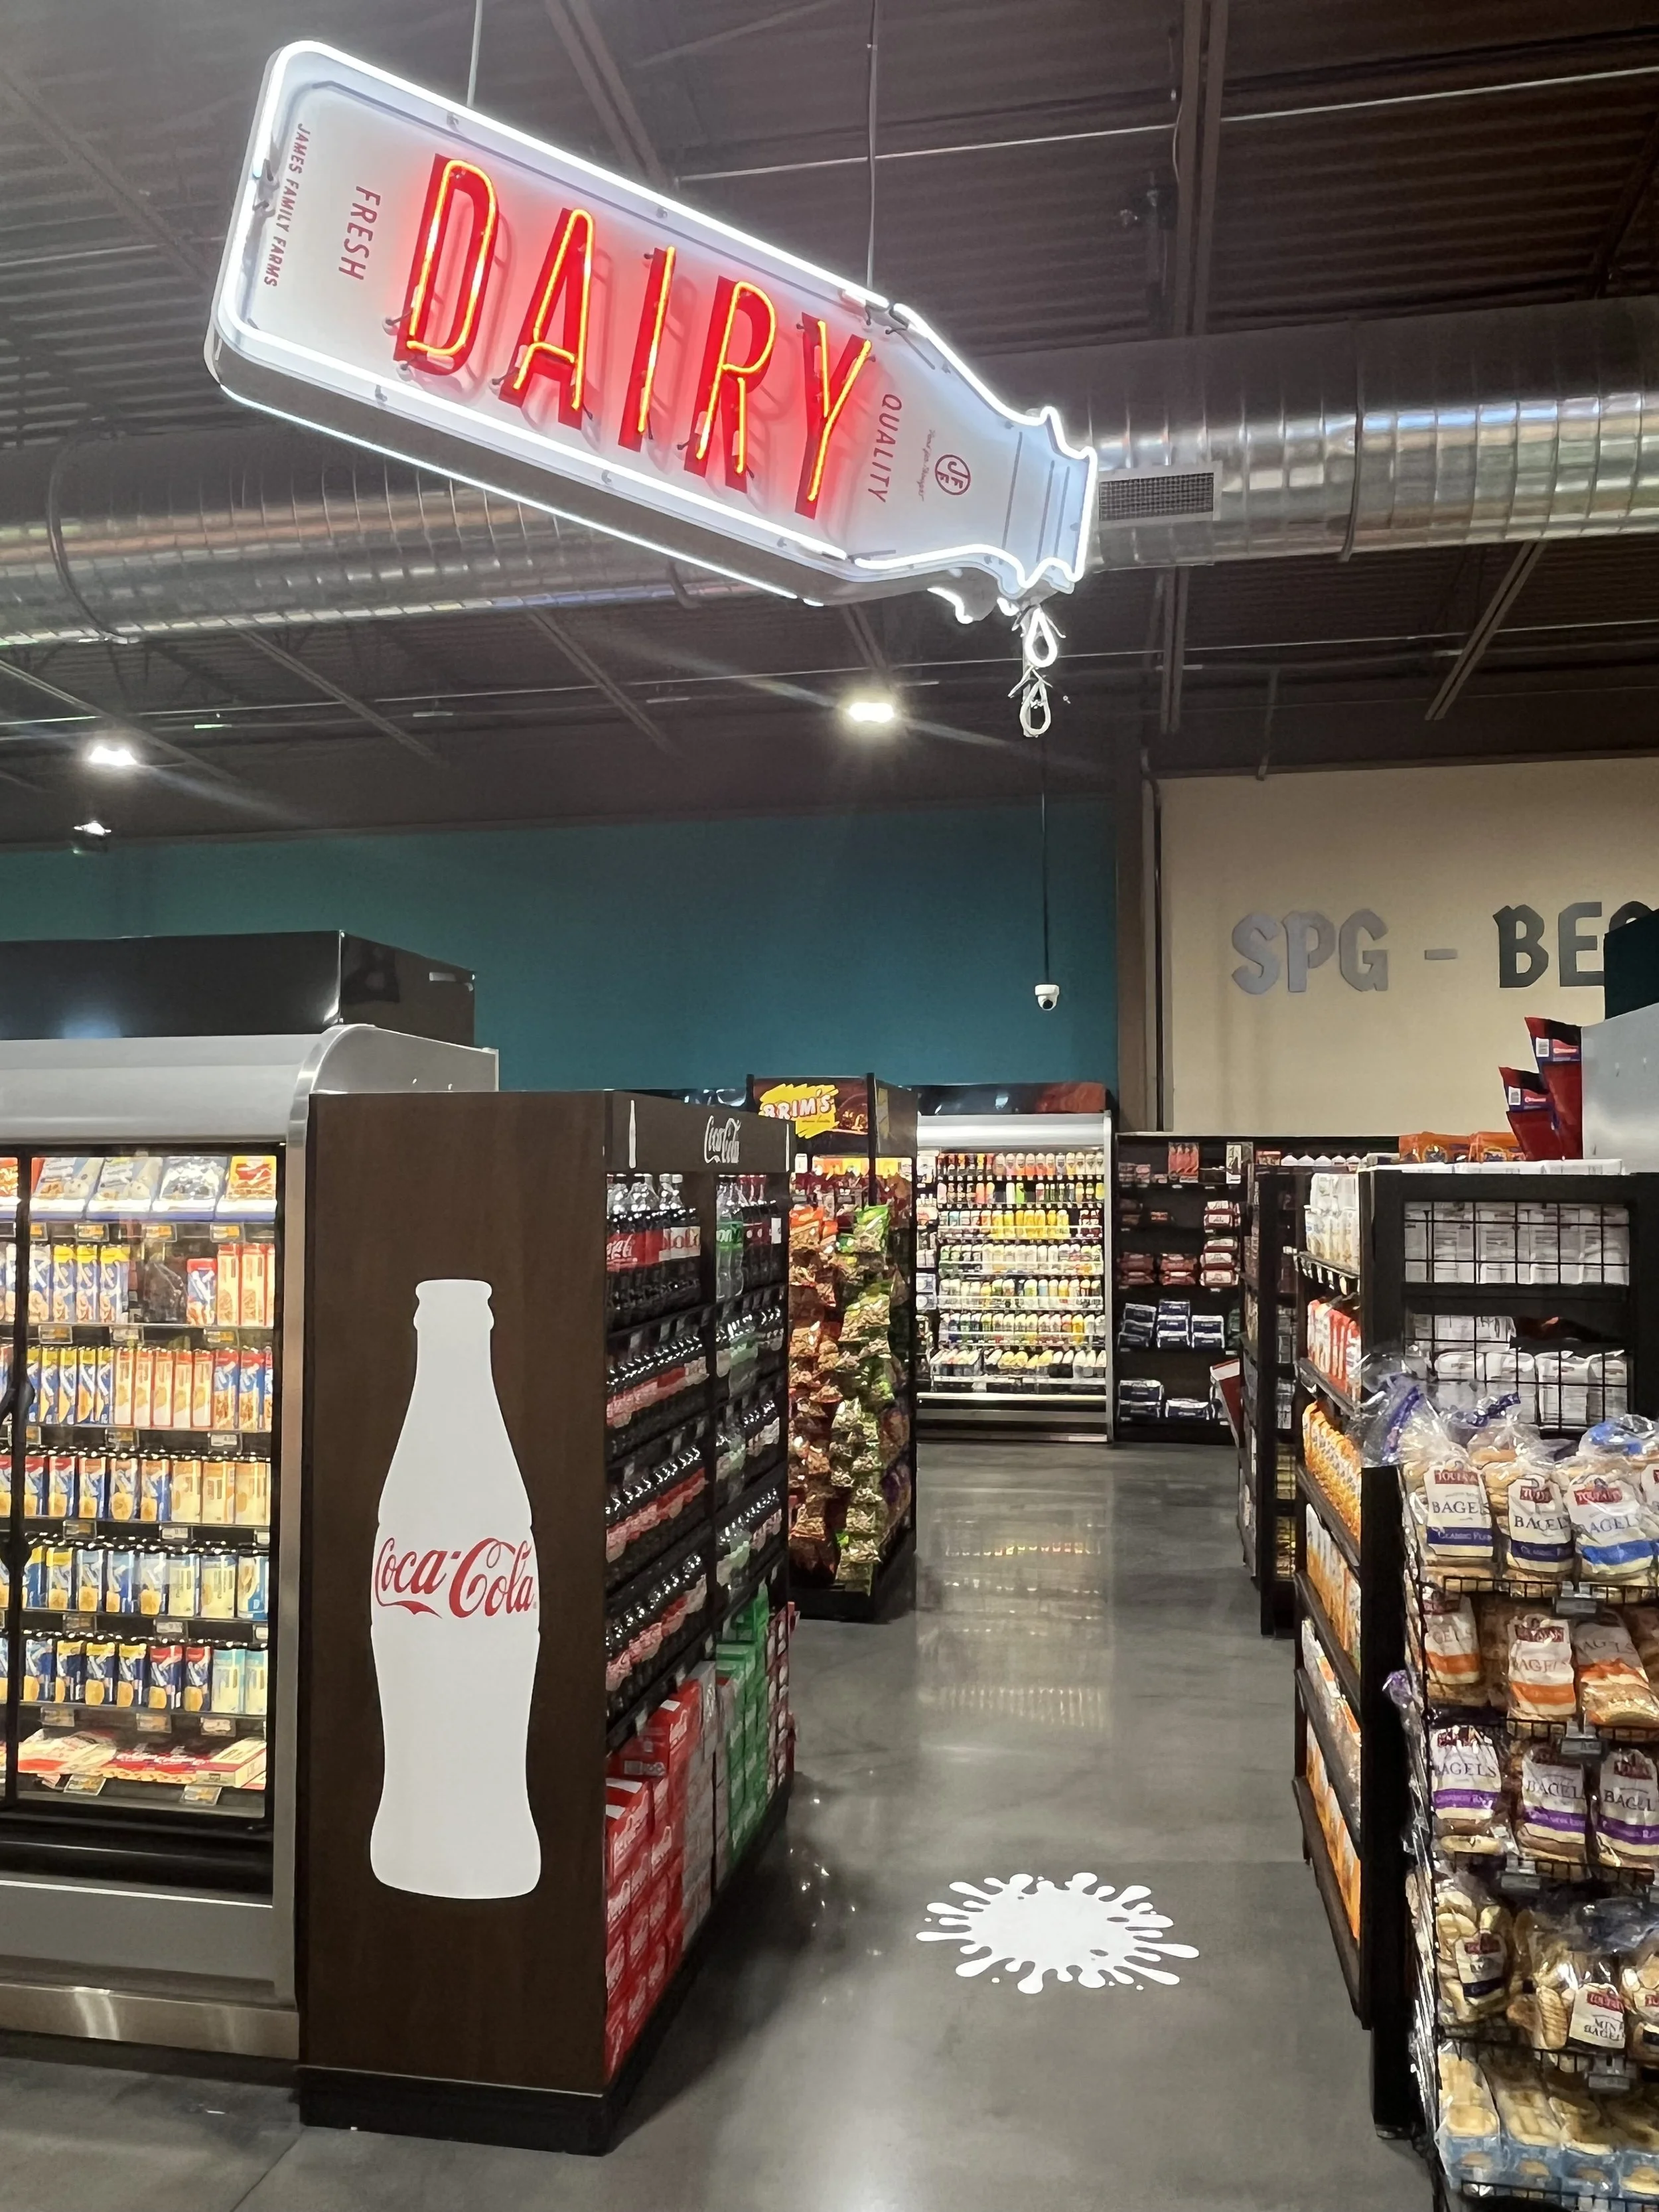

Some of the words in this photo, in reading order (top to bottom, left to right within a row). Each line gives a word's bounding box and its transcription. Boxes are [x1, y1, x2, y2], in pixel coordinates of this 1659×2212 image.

[289, 123, 311, 174] JAMES
[275, 178, 299, 233] FAMILY
[338, 186, 381, 280] FRESH
[263, 236, 287, 287] FARMS
[394, 153, 871, 520] DAIRY
[867, 394, 903, 503] QUALITY
[1231, 909, 1390, 995] SPG
[374, 1536, 536, 1619] Coca-Cola
